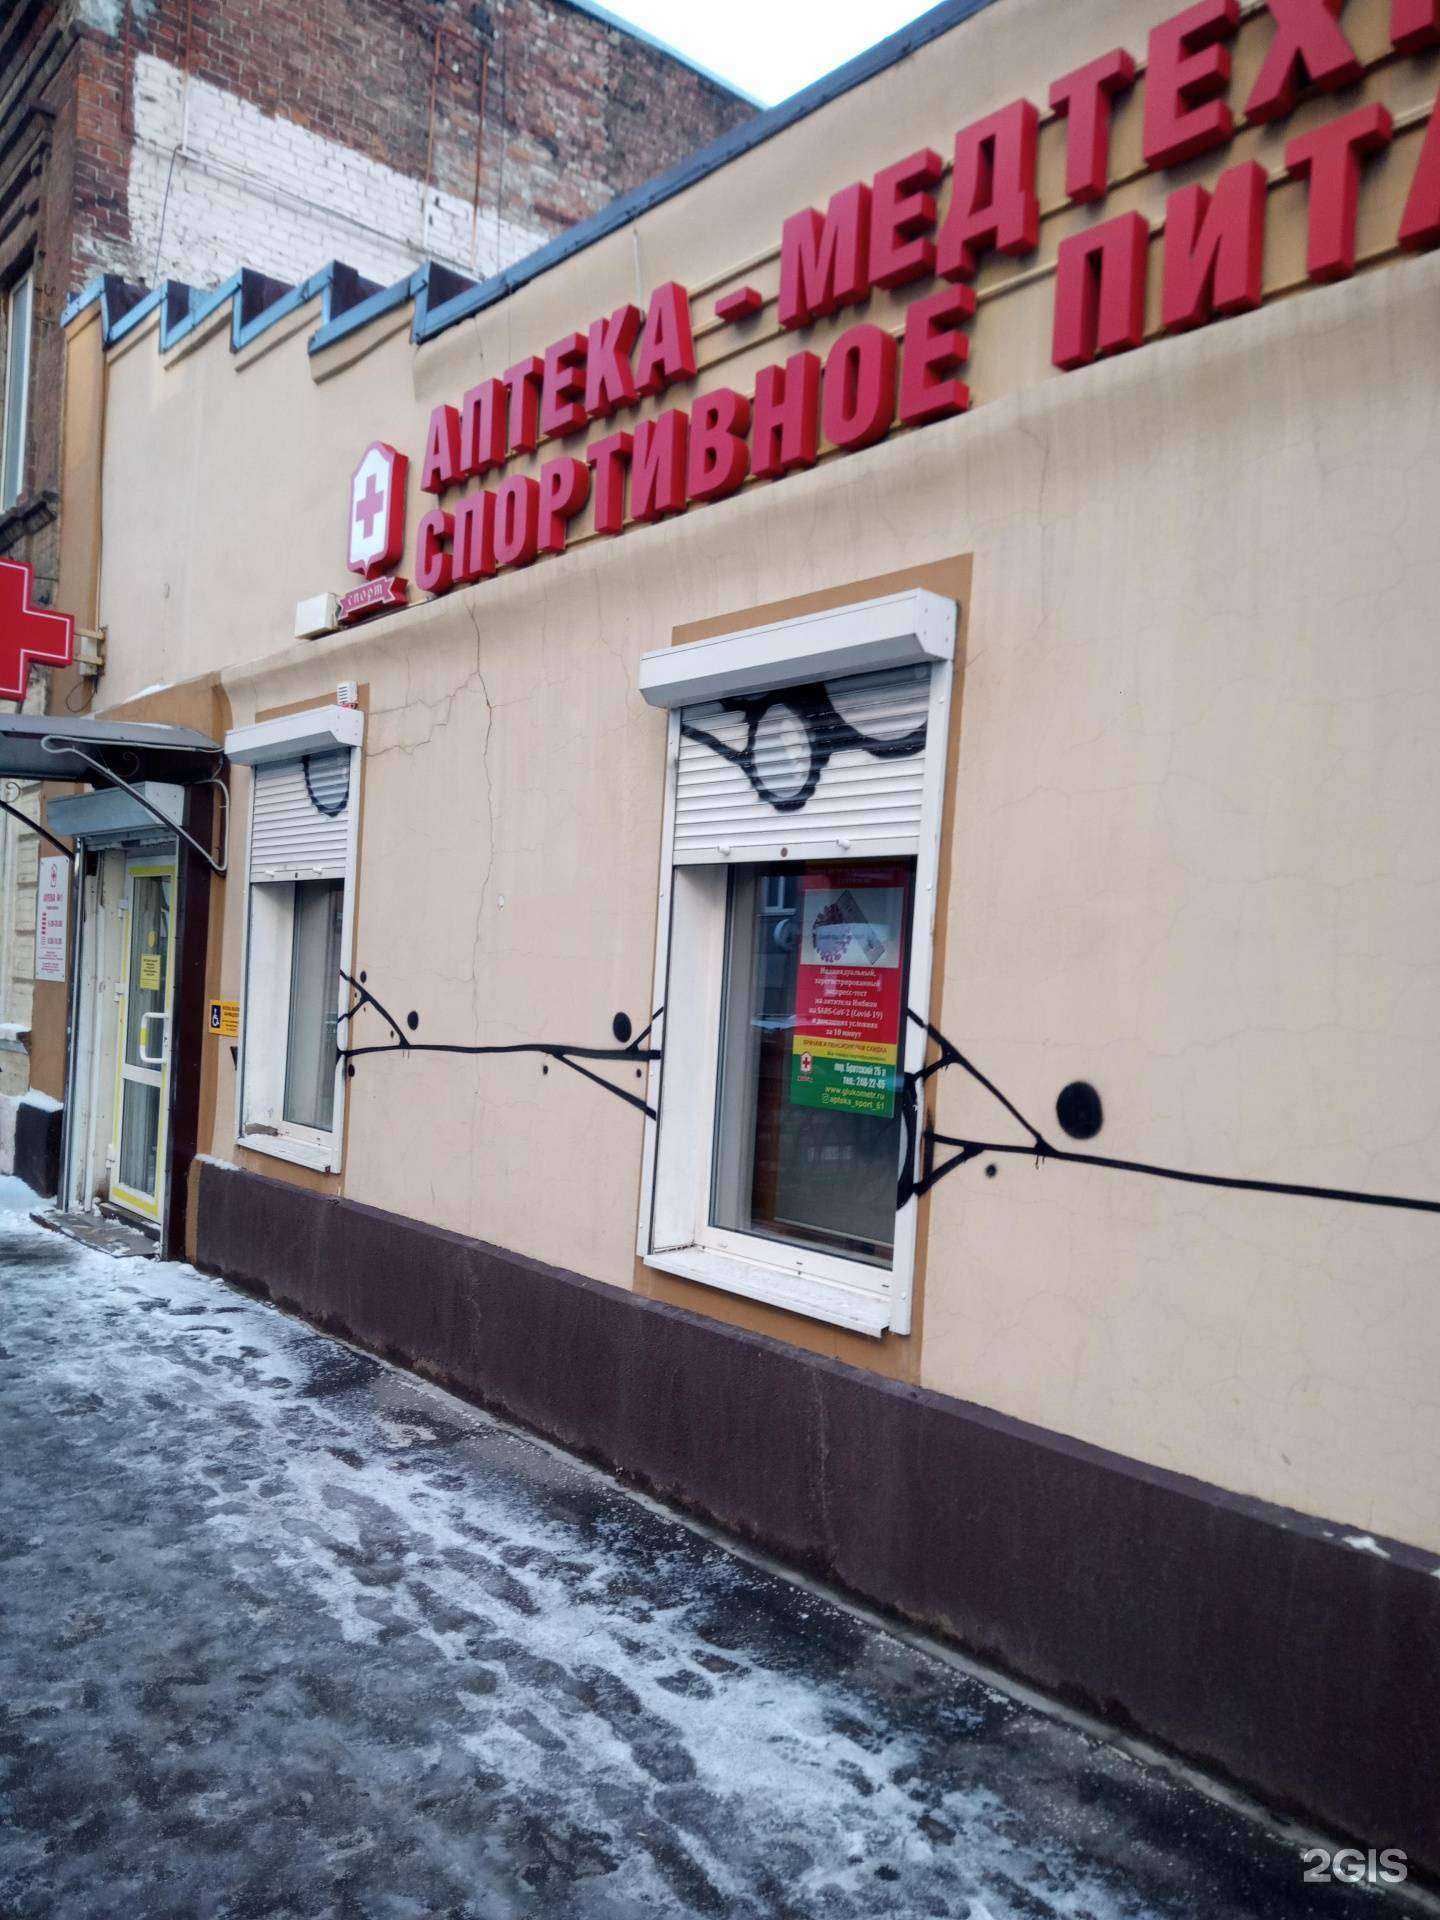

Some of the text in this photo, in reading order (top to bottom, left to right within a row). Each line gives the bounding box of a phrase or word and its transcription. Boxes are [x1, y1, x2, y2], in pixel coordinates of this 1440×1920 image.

[421, 0, 1440, 493] АПТЕКА - МЕДТЕХ
[415, 283, 975, 593] СПОРТИВНОЕ
[842, 1030, 862, 1039] минут
[850, 1009, 883, 1020] (Covid-19)
